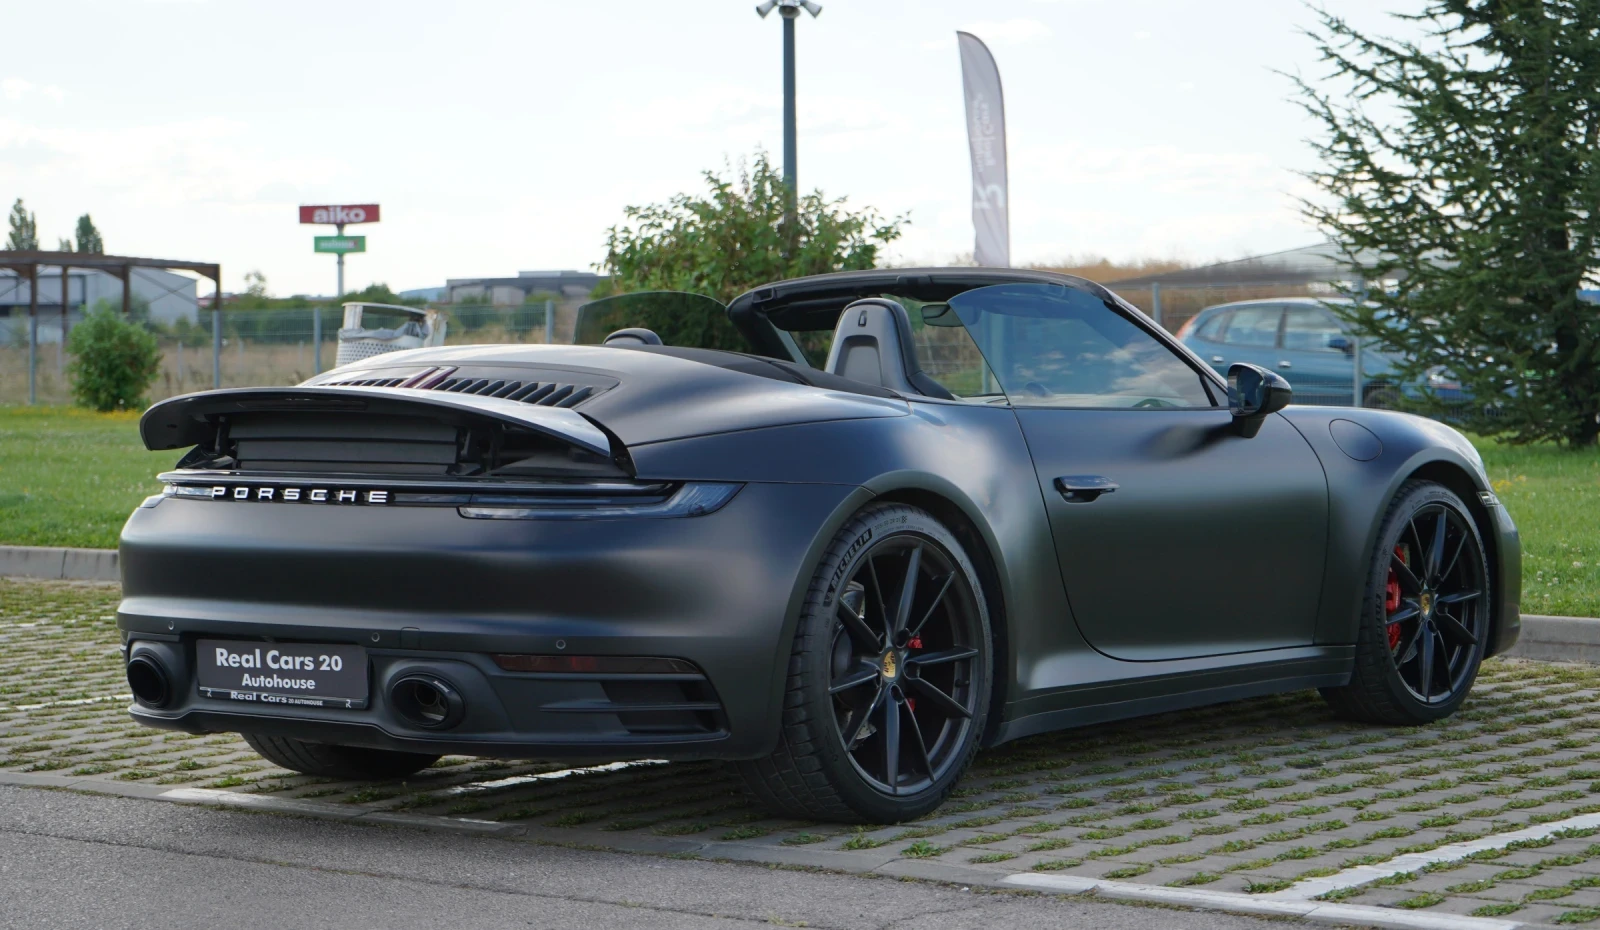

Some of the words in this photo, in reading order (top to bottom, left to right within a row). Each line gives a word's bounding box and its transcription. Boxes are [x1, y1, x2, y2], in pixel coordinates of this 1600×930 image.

[313, 205, 366, 223] aiko
[211, 486, 388, 503] PORSCHE
[831, 529, 870, 589] MICHELIN
[215, 647, 262, 669] Real
[266, 650, 315, 671] Cars
[319, 655, 343, 672] 20
[241, 673, 316, 690] Autohouse
[230, 691, 257, 701] Real
[260, 693, 288, 704] Cars
[295, 698, 323, 706] AUTOHOUSE
